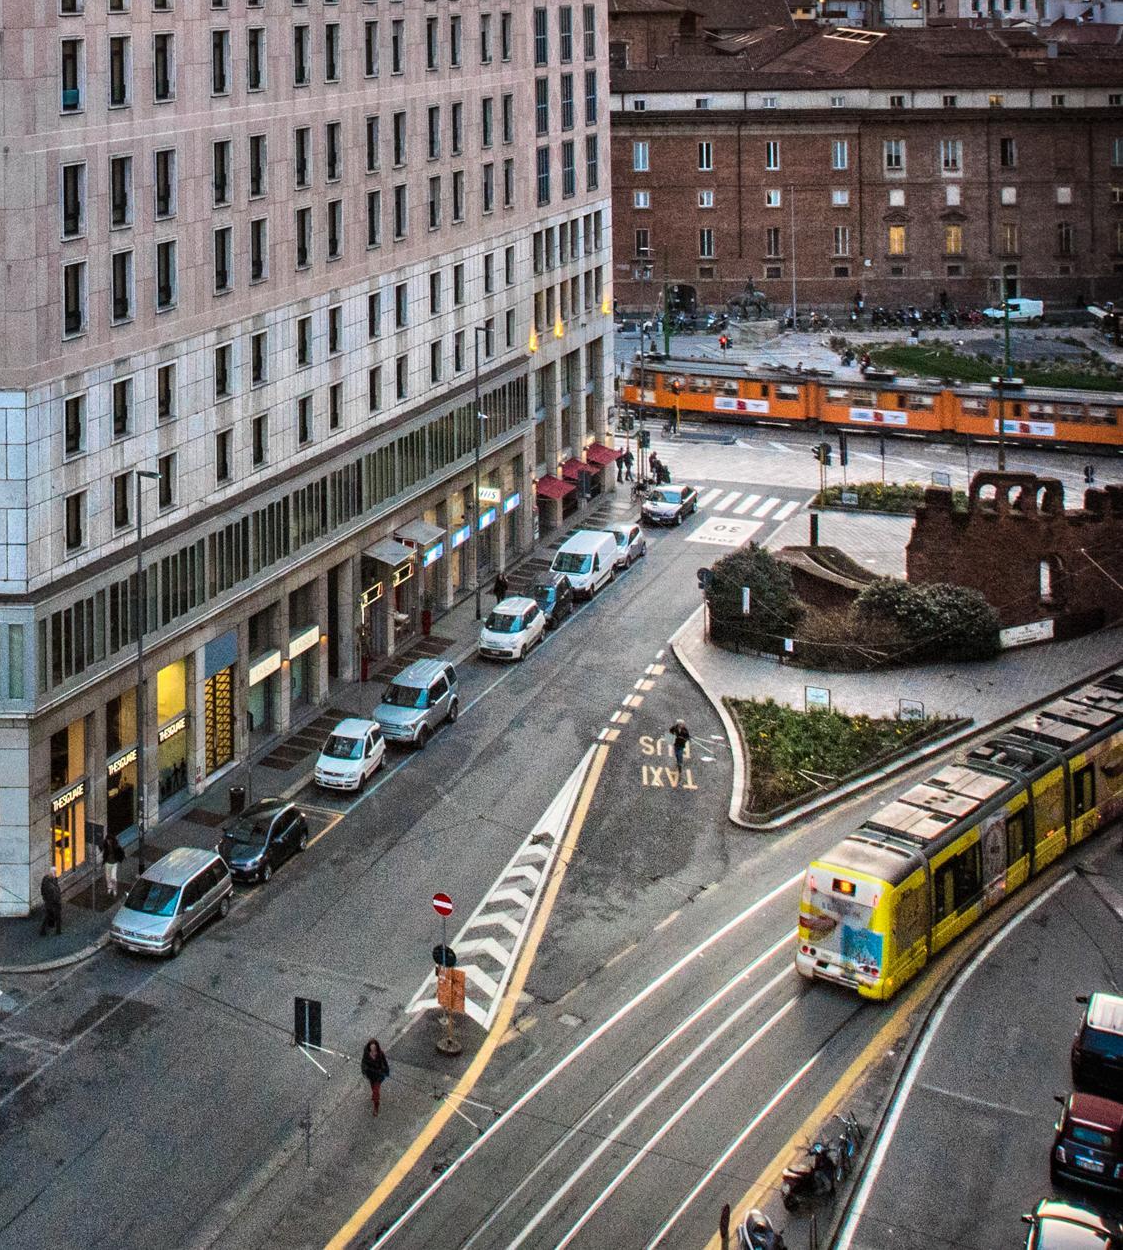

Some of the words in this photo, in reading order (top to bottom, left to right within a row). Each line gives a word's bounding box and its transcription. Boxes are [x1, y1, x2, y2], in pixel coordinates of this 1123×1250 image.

[713, 524, 742, 534] 30
[108, 749, 137, 776] THESQUARE
[641, 765, 699, 790] TAXI
[52, 783, 84, 812] THESQUARE
